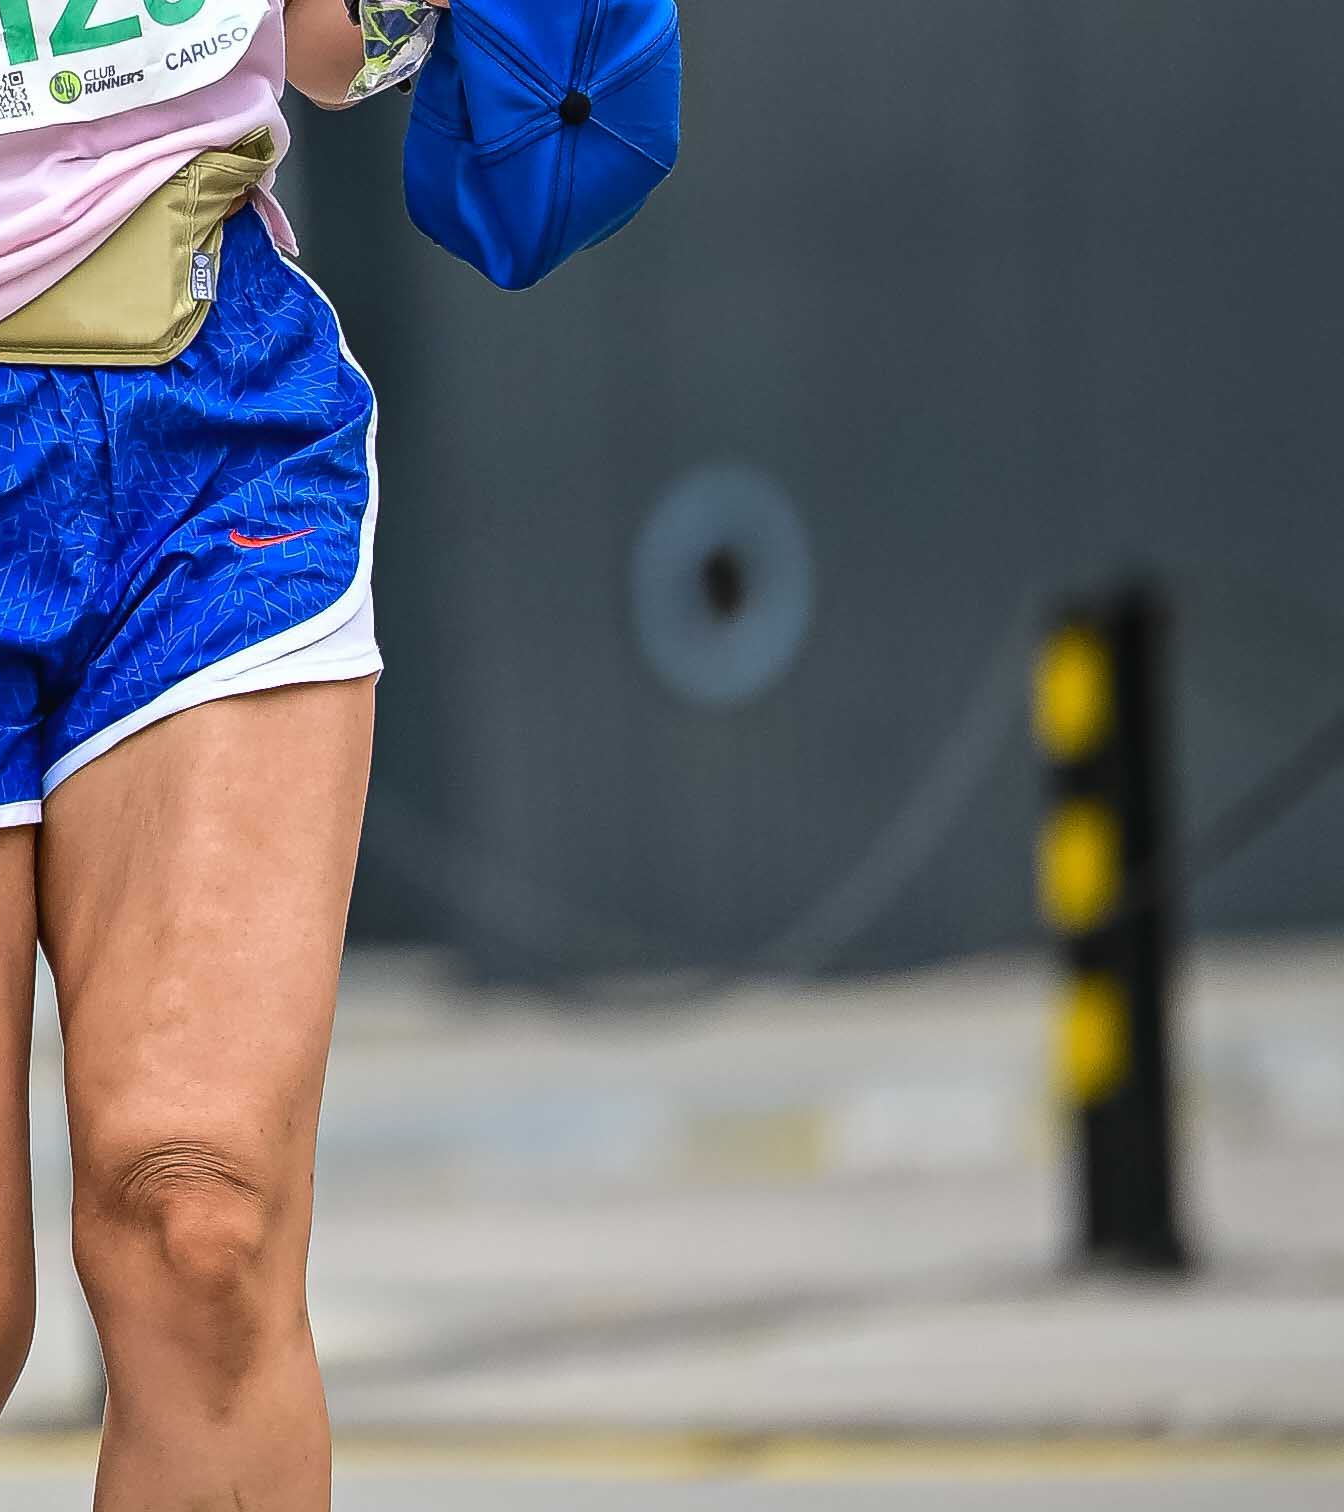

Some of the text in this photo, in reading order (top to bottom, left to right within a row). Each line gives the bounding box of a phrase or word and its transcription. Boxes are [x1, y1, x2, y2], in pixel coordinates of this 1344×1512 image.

[165, 27, 248, 71] CARUSO
[83, 65, 117, 82] CLUB
[84, 70, 145, 95] RUNNER'S
[195, 268, 209, 299] RFID
